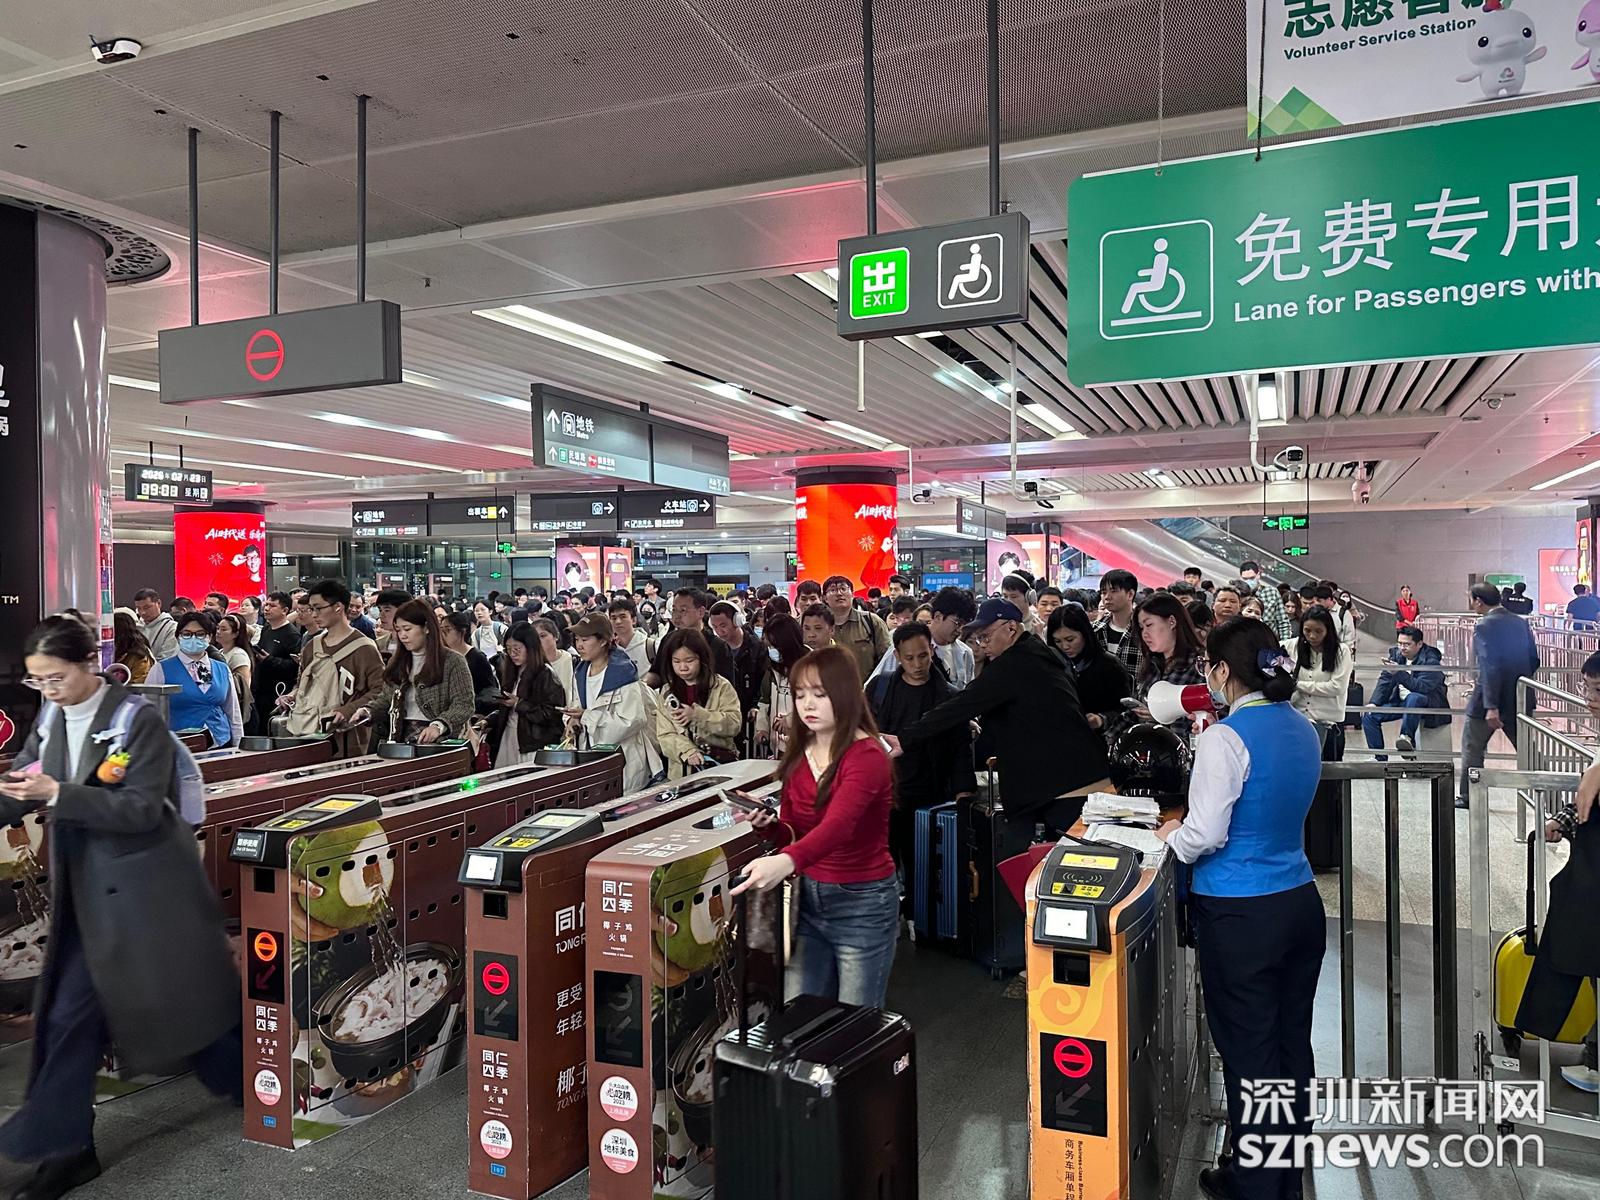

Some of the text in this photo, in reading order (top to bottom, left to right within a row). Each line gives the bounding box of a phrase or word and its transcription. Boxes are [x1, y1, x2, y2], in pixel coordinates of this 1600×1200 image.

[1284, 17, 1477, 60] Volunteer Service Station
[1235, 175, 1600, 286] 免费专用
[863, 262, 895, 292] 出
[863, 292, 895, 308] EXIT
[1234, 266, 1600, 322] Lane for Passengers with
[576, 414, 594, 434] 地铁
[664, 500, 687, 510] 火车站
[602, 880, 633, 897] 同仁
[602, 897, 633, 913] 四季
[602, 921, 633, 932] 椰子鸡
[609, 933, 627, 943] 火锅
[556, 982, 582, 1011] 更受
[256, 1005, 278, 1020] 同仁
[256, 1018, 278, 1032] 四季
[482, 1050, 508, 1065] 同仁
[482, 1064, 508, 1079] 四季
[604, 1144, 635, 1157] 地标美食
